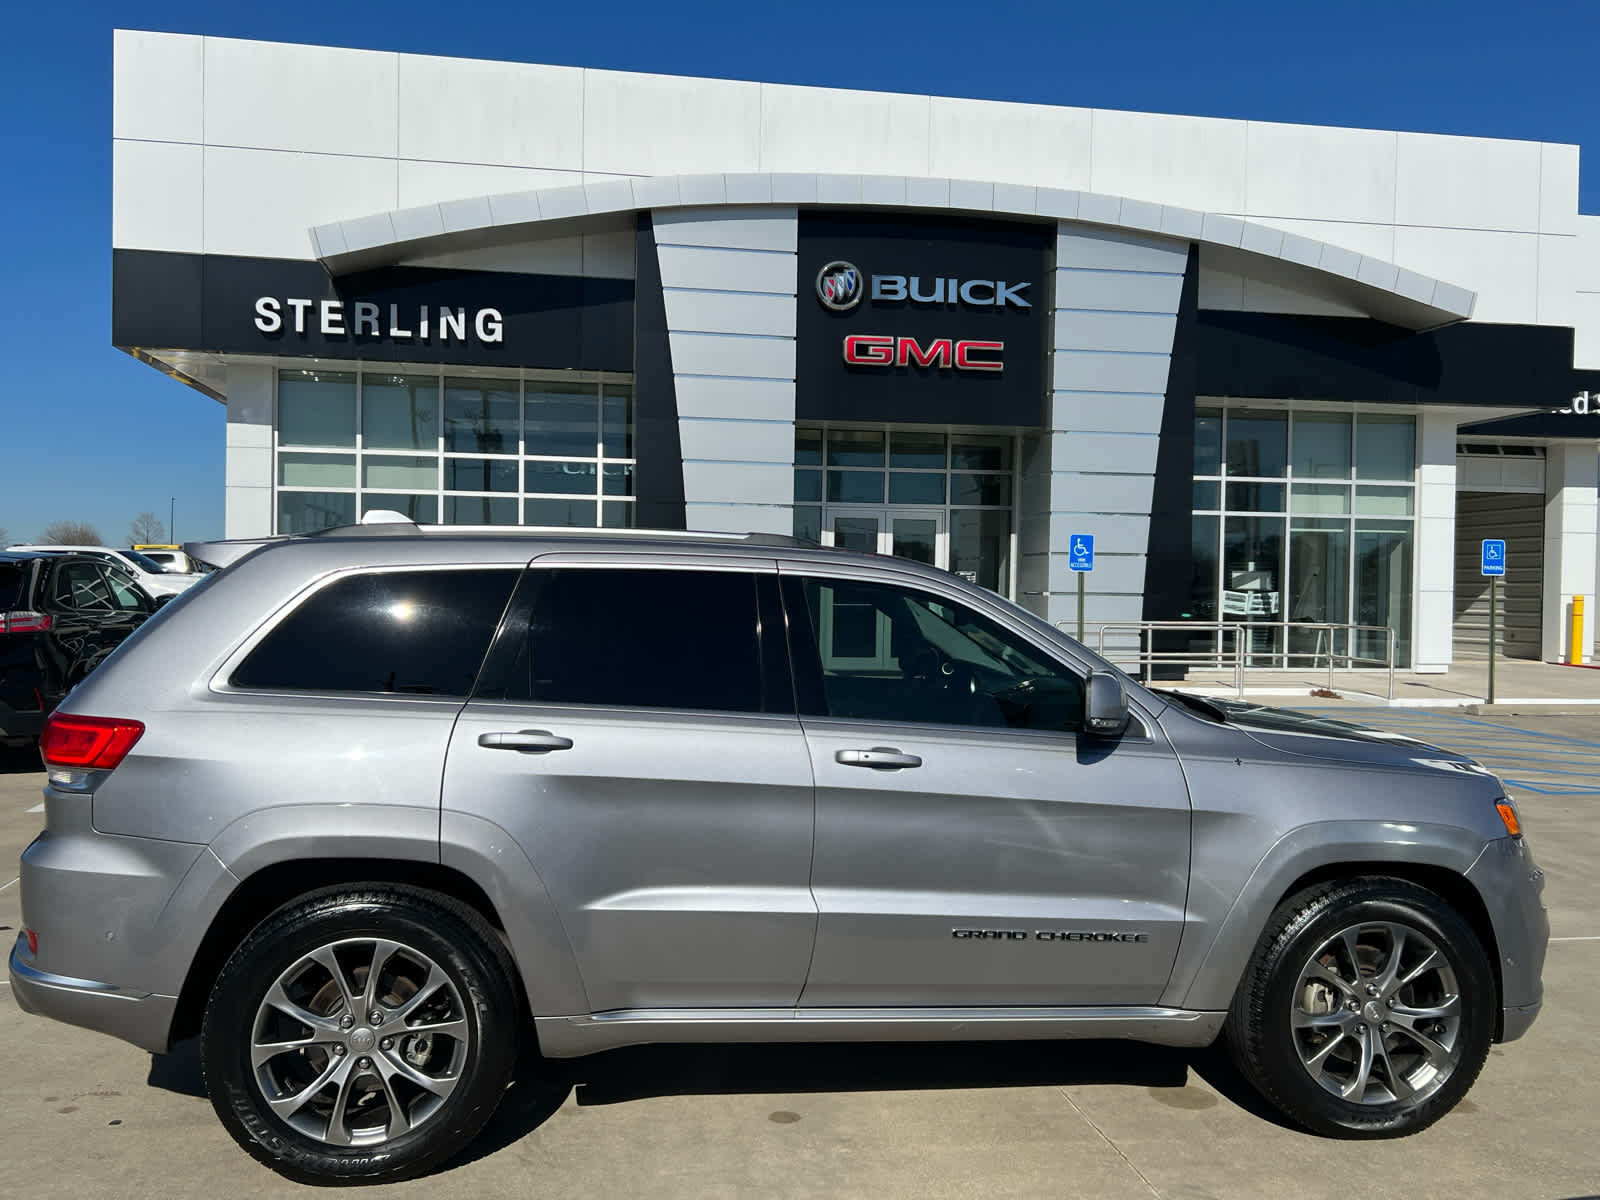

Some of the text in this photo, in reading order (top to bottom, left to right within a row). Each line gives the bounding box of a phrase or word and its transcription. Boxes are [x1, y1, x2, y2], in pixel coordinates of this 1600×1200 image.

[871, 274, 1033, 307] BUICK
[254, 296, 504, 343] STERLING
[843, 334, 1004, 372] GMC
[952, 928, 1150, 943] GRAND CHEROKEE
